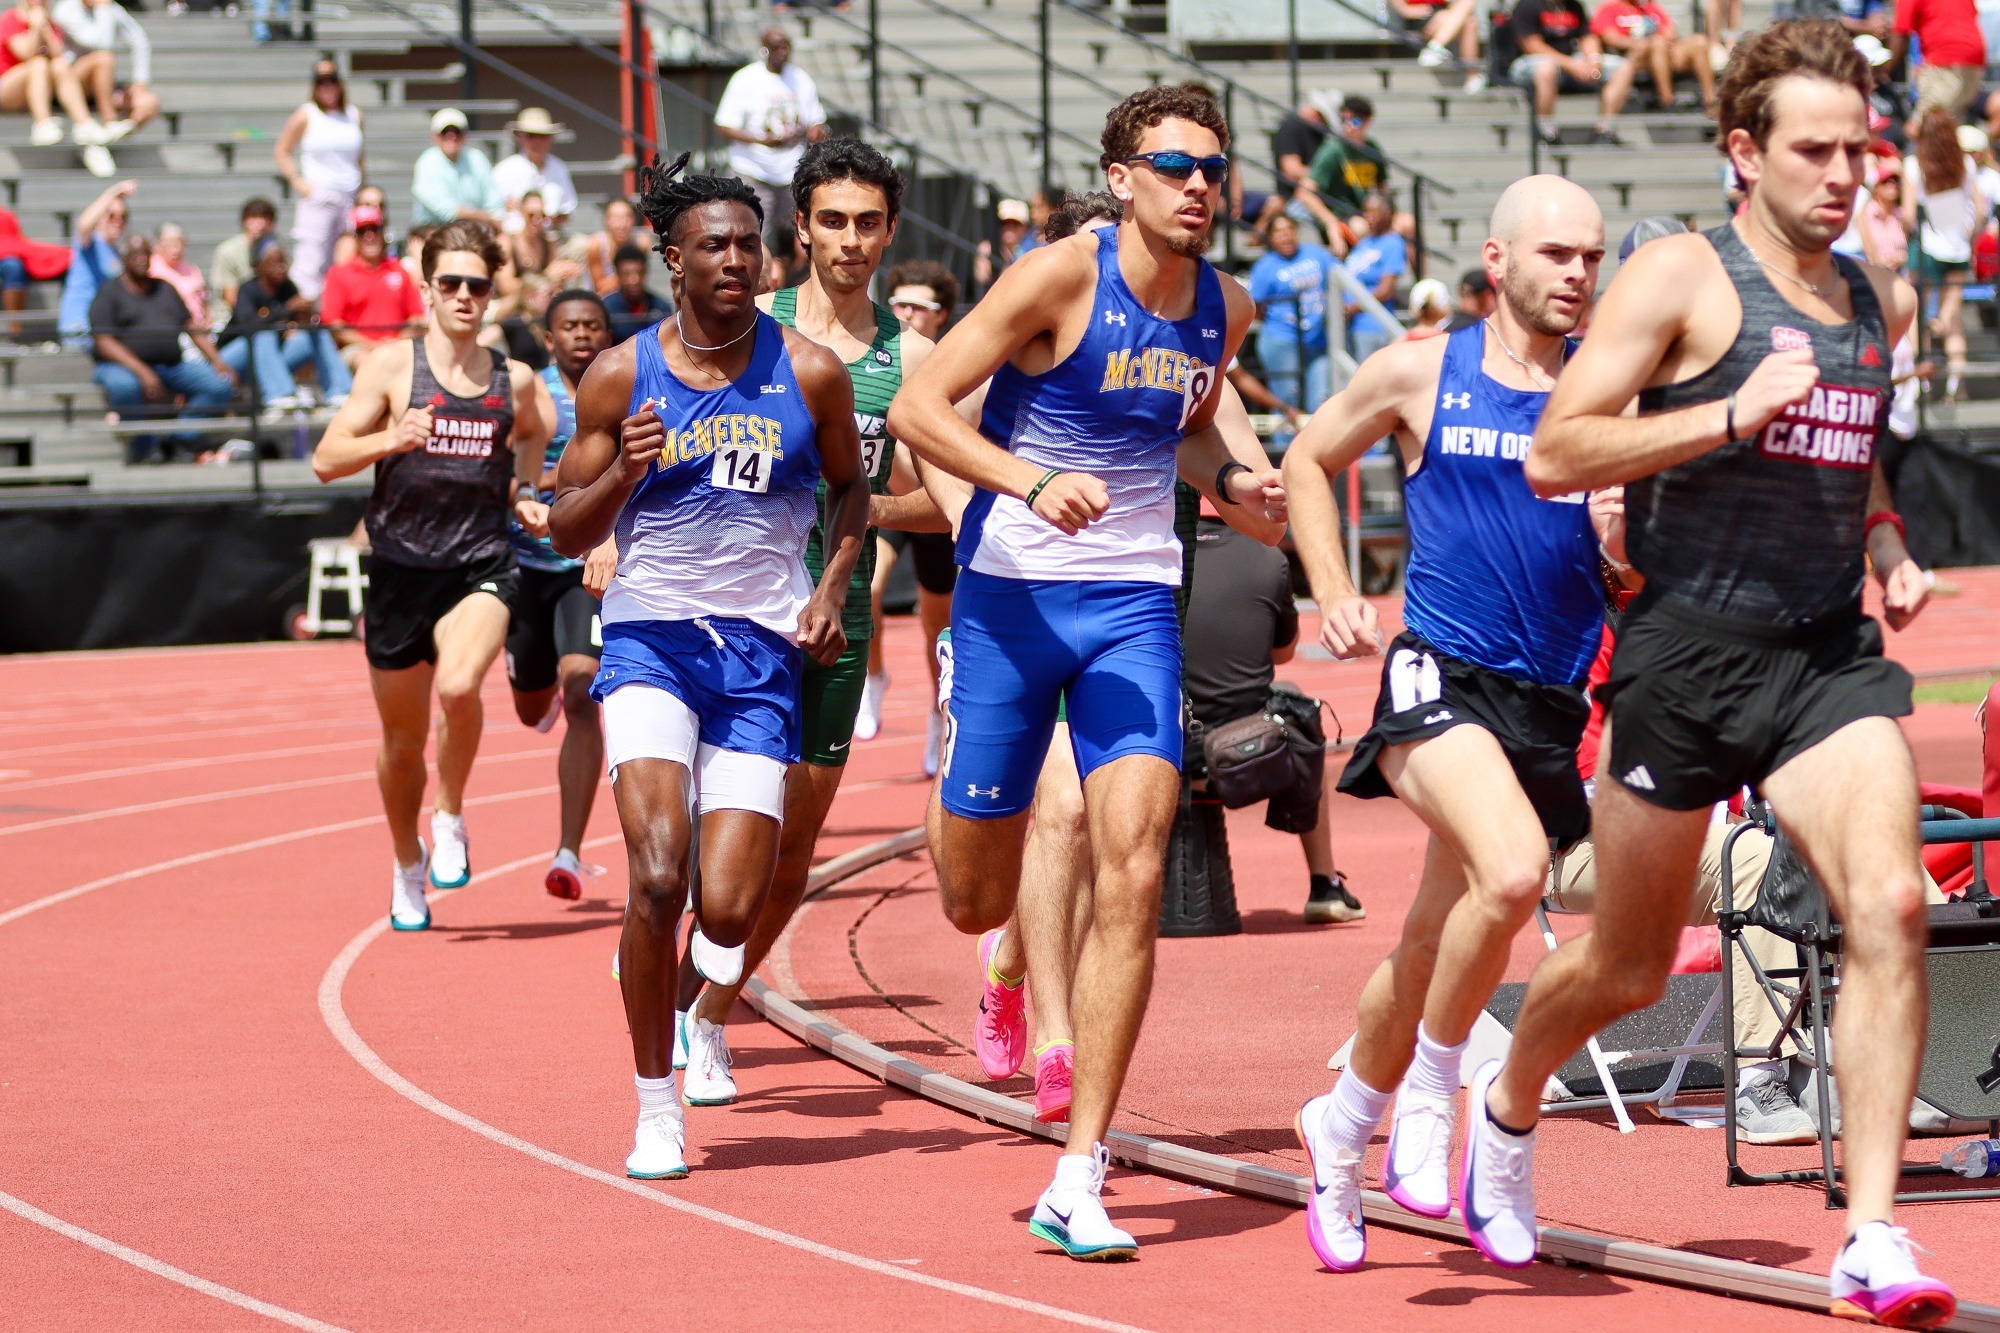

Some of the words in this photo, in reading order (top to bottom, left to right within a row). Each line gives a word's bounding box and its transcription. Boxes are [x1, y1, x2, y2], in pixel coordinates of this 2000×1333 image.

[875, 350, 891, 363] GG
[1100, 346, 1210, 394] McNEE
[1185, 371, 1209, 420] 8
[425, 436, 494, 456] CAJUNS
[1440, 426, 1499, 457] NEW
[1501, 432, 1532, 461] OR
[1764, 421, 1874, 464] CAJUNS
[723, 449, 760, 489] 14
